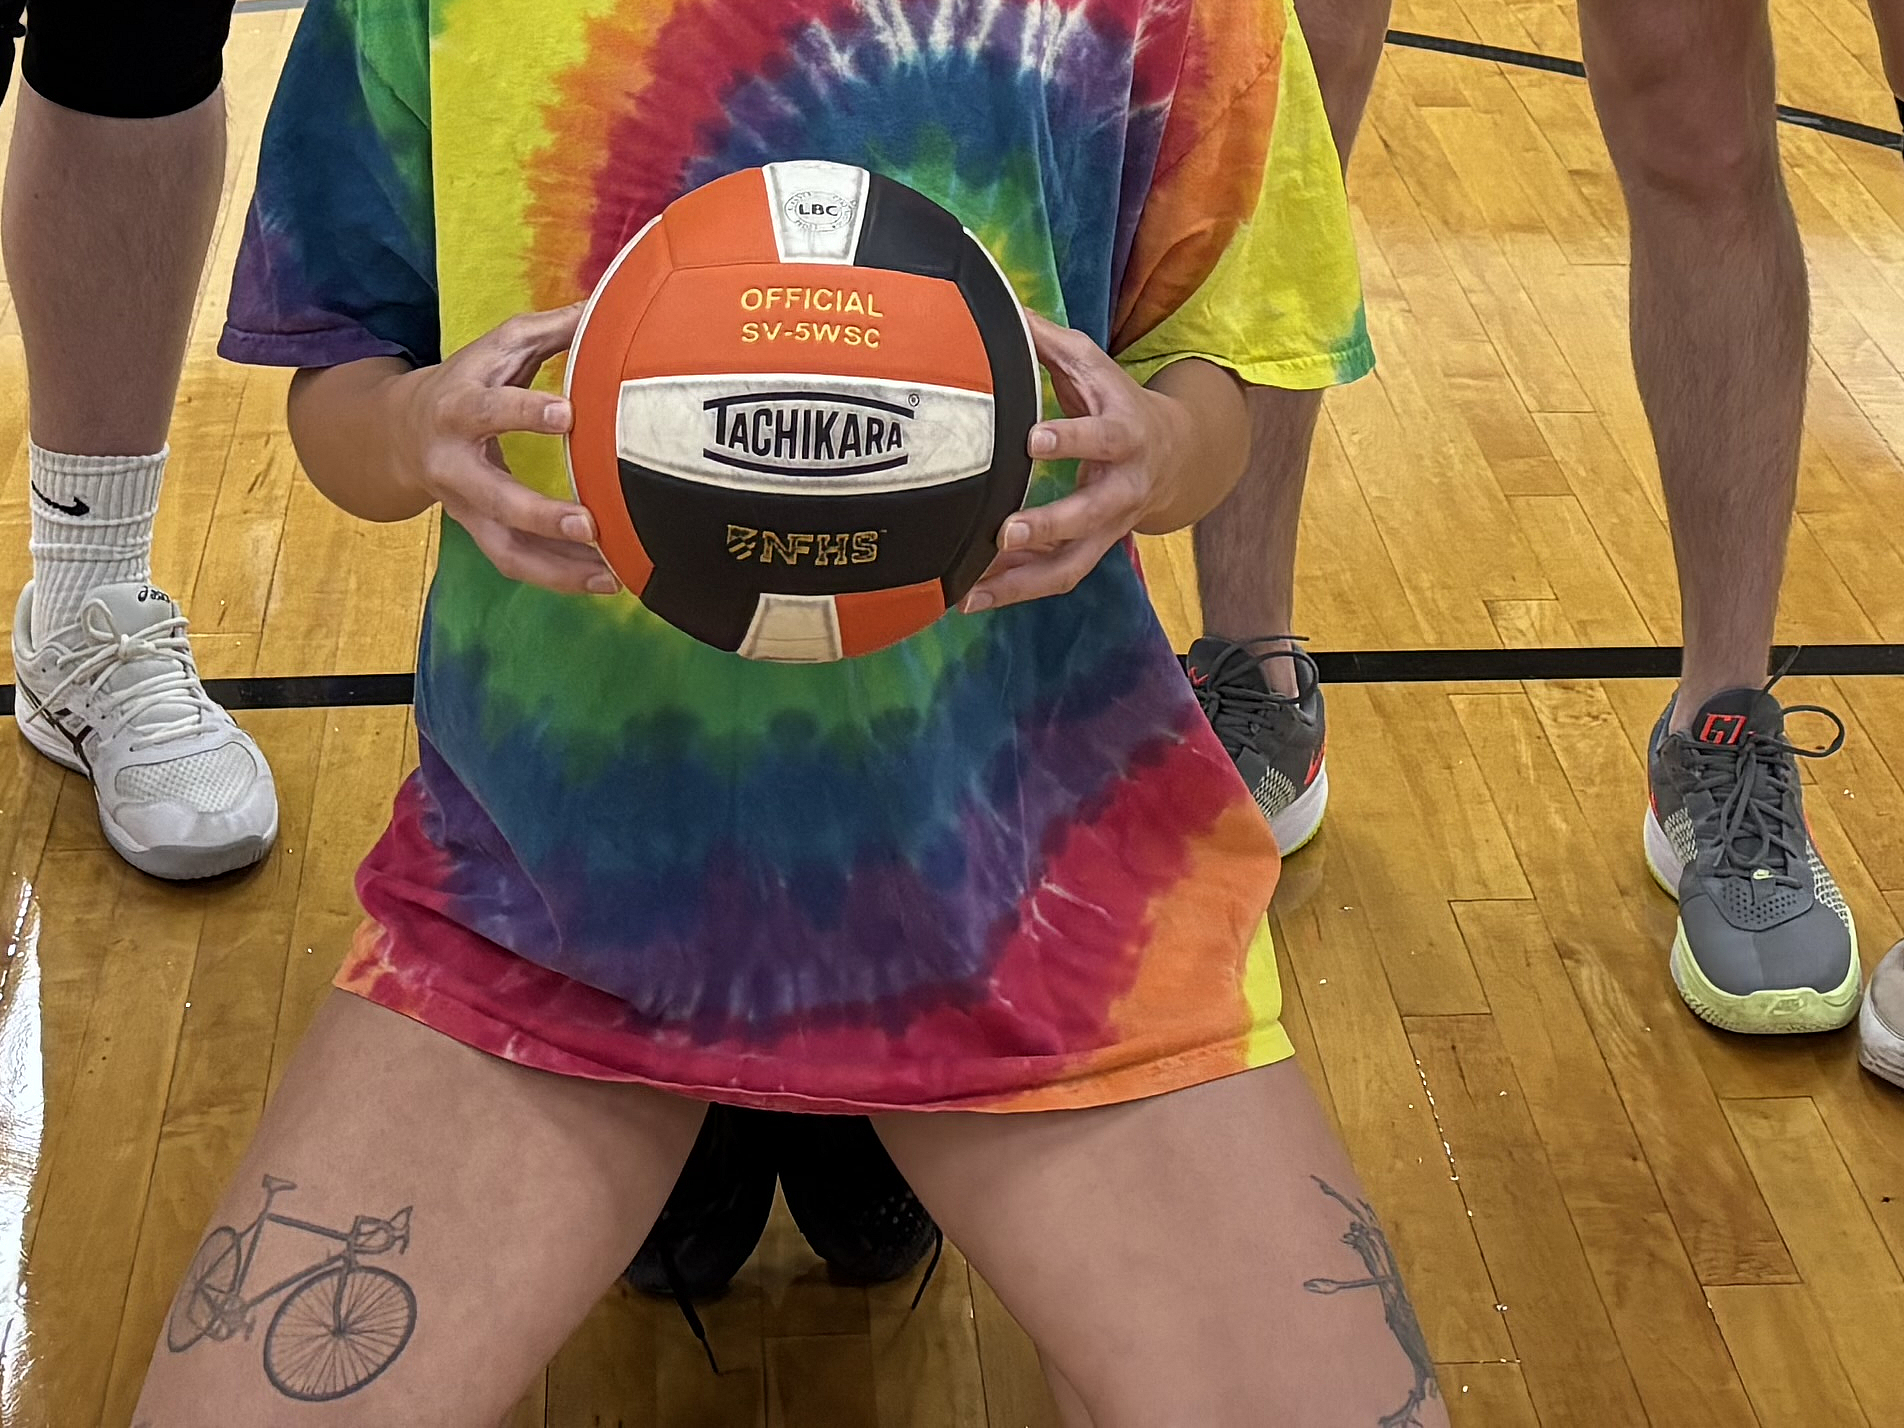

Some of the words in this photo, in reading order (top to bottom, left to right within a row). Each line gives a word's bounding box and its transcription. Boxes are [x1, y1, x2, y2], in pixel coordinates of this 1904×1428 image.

[798, 203, 838, 217] LBC
[740, 286, 884, 318] OFFICIAL
[741, 321, 881, 349] SV-5WSC
[703, 398, 904, 461] TACHIKARA
[759, 530, 880, 566] NFHS
